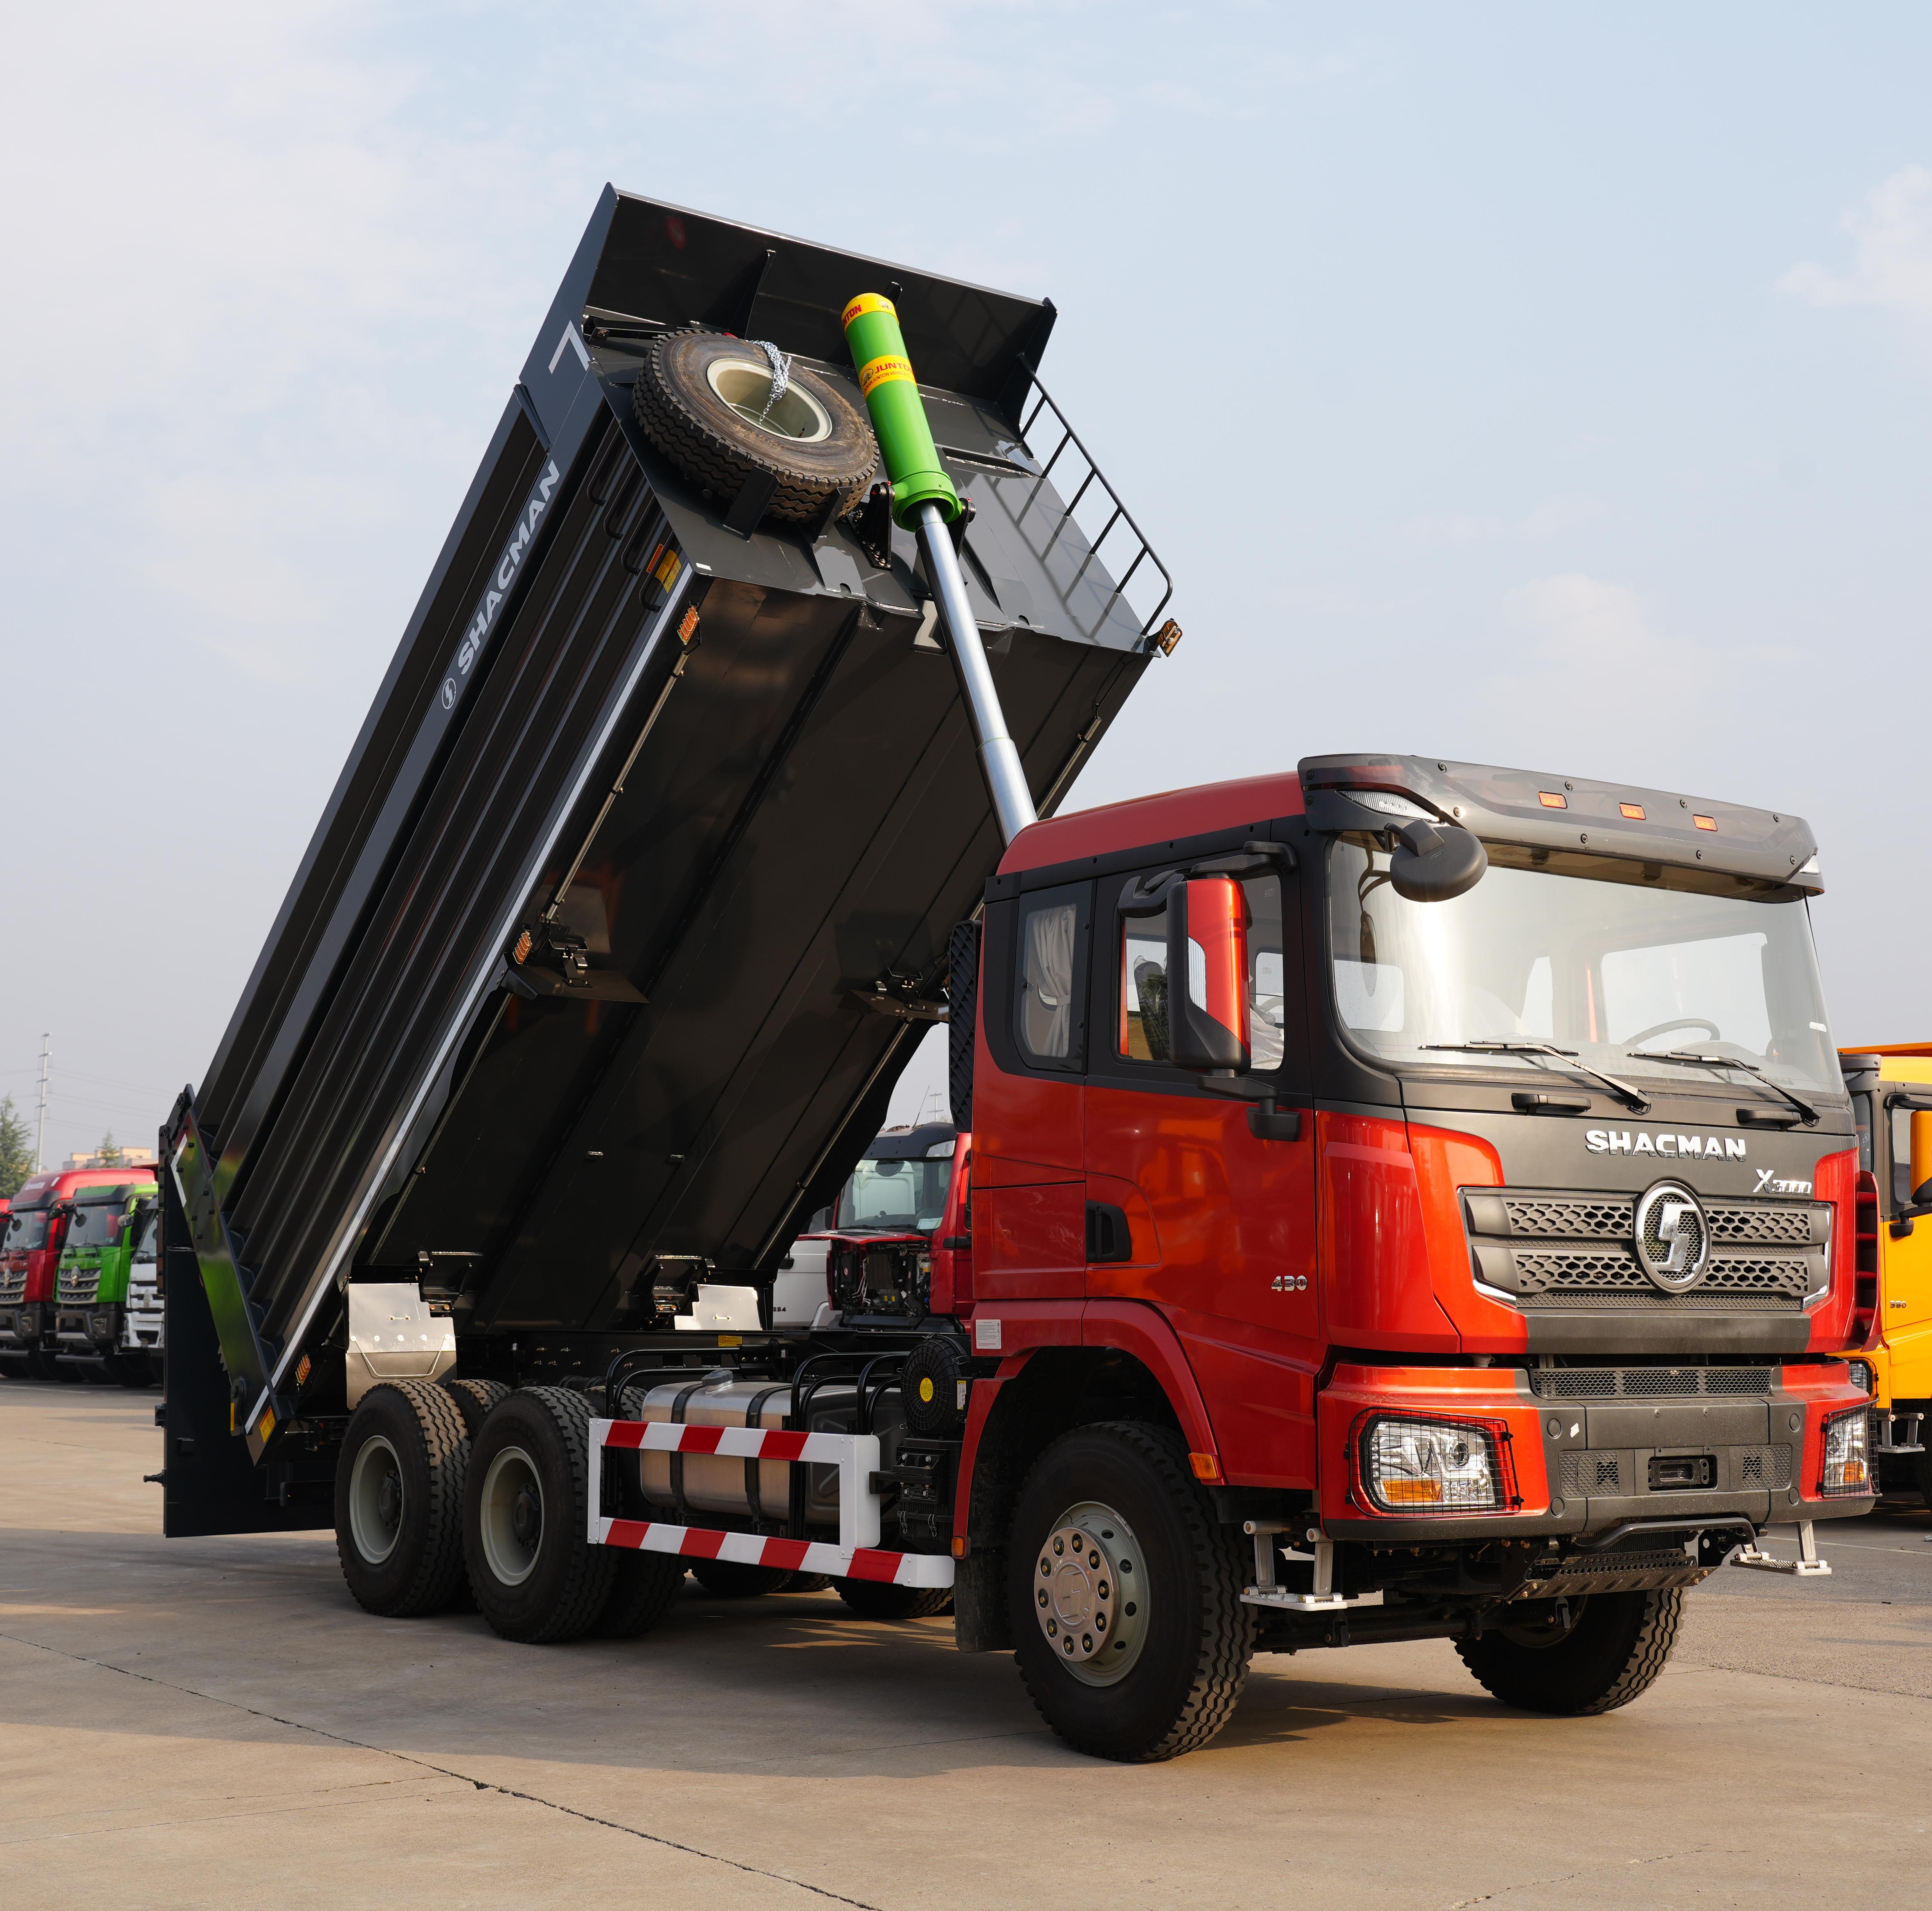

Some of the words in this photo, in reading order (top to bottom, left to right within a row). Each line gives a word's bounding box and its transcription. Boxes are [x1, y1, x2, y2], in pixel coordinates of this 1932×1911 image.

[843, 304, 861, 326] NTON
[873, 373, 889, 382] JUNTON
[458, 460, 560, 674] SHACMAN
[1585, 1130, 1746, 1162] SHACMAN
[1753, 1169, 1812, 1196] X3000
[1271, 1275, 1307, 1291] 430
